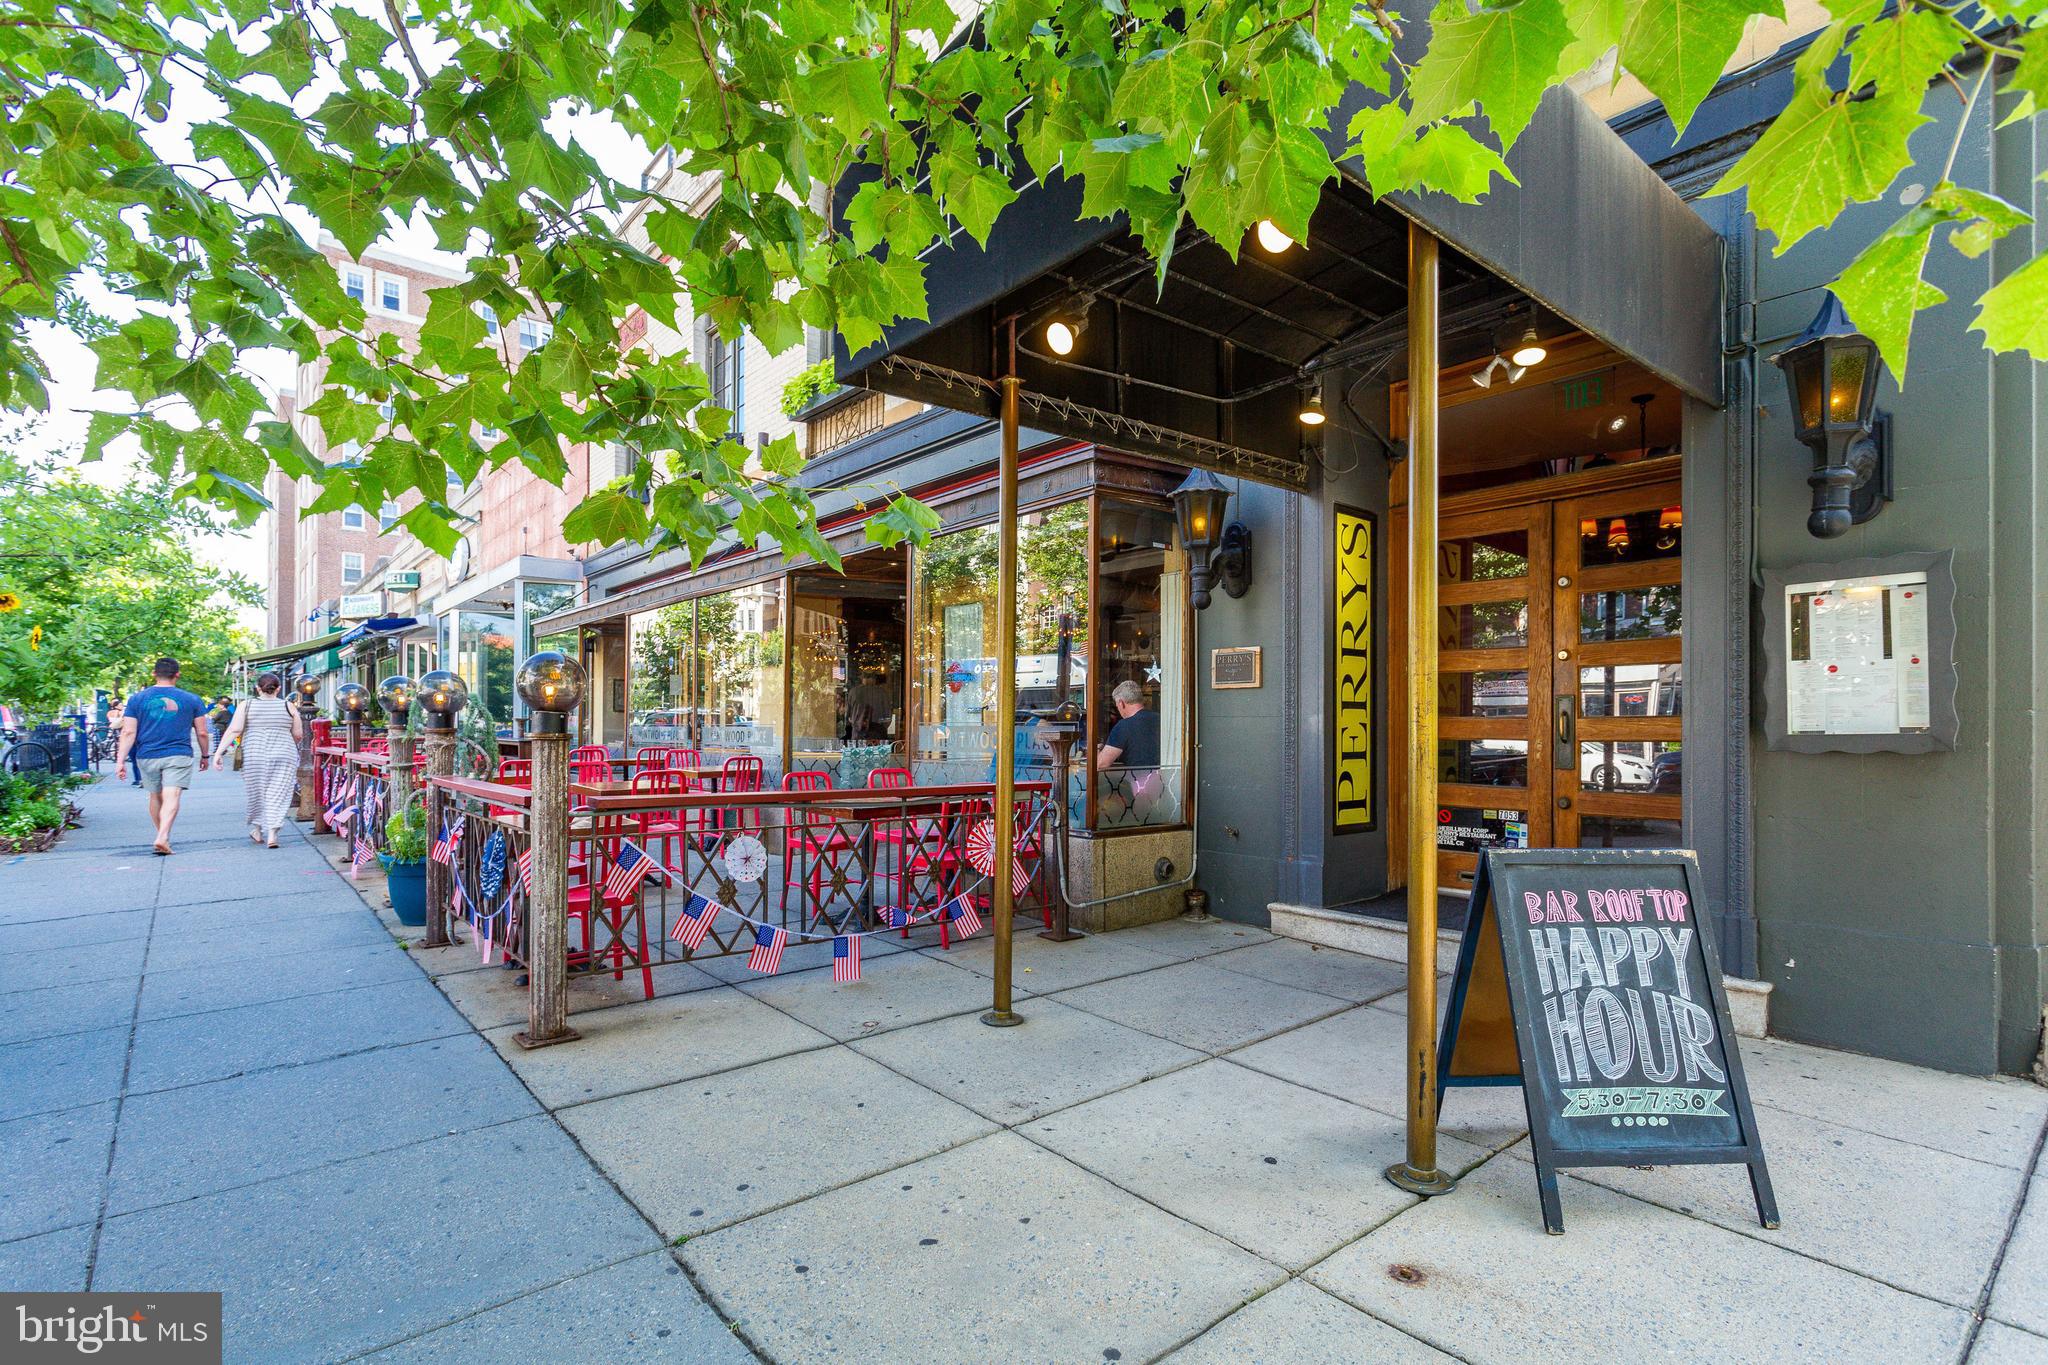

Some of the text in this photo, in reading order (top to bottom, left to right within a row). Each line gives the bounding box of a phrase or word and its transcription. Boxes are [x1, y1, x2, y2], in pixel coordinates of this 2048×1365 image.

[1217, 654, 1252, 664] PERRY'S
[1338, 522, 1369, 819] PERRYS
[1499, 810, 1518, 820] 7053
[1459, 831, 1497, 840] RESTAURANT
[1472, 827, 1489, 835] CORP
[1524, 890, 1584, 924] BAR
[1528, 926, 1693, 1001] HAPPY
[1543, 987, 1726, 1083] HOUR
